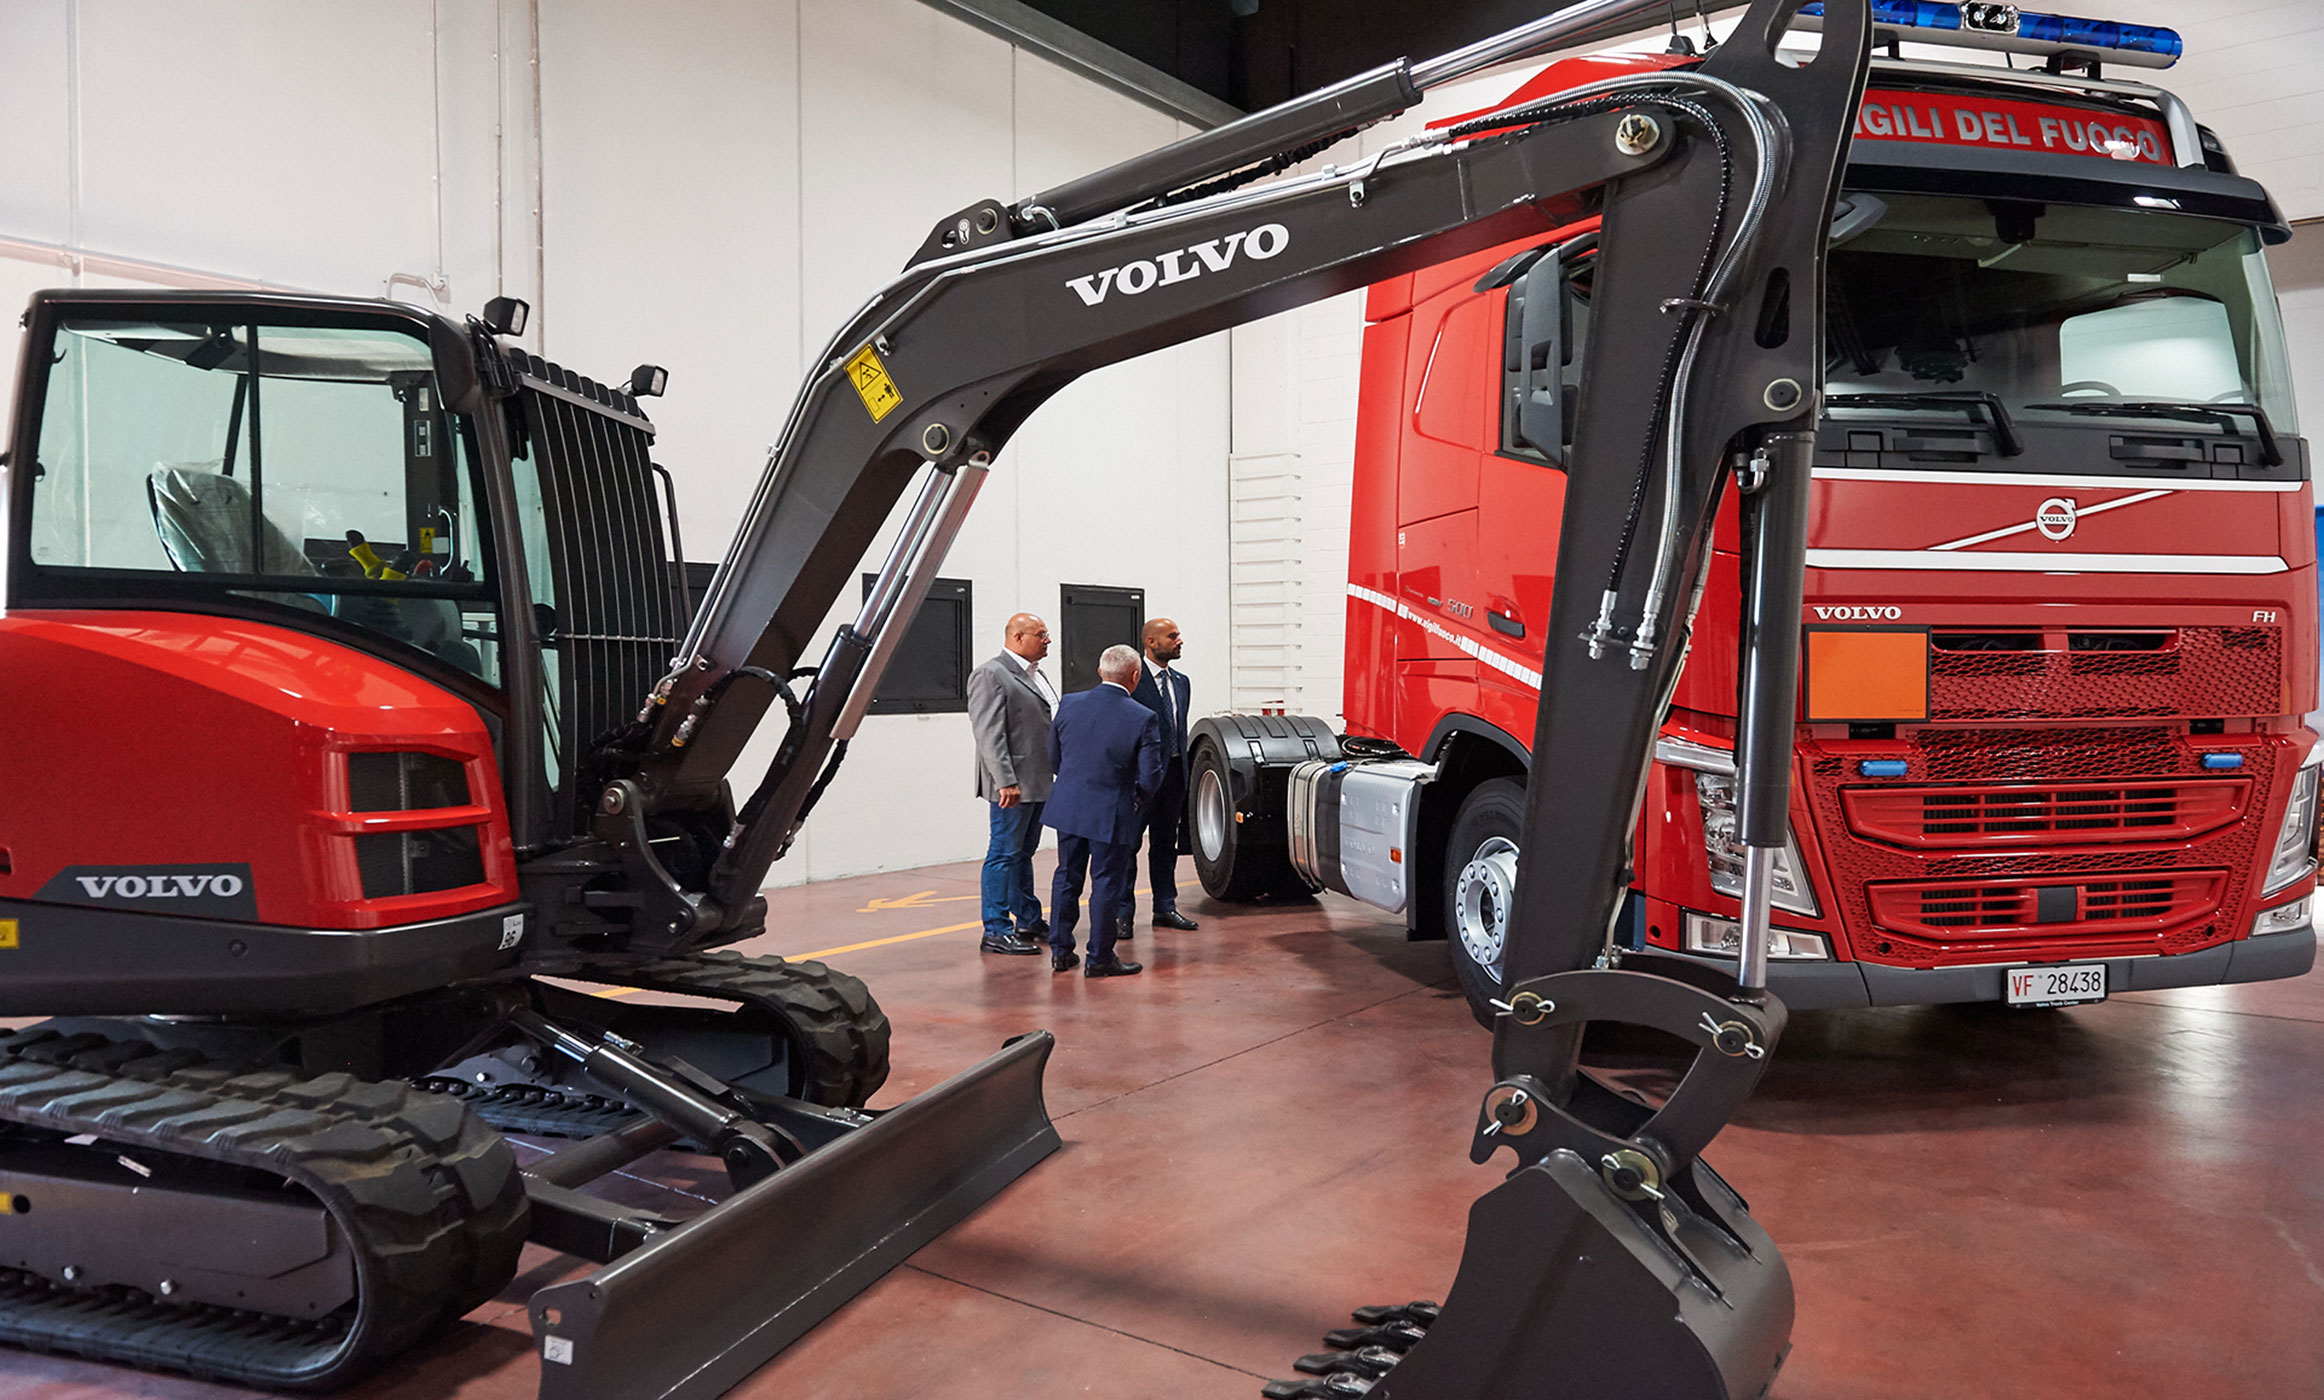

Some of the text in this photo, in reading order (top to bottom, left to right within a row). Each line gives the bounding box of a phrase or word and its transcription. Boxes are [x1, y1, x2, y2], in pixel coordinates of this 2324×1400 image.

[1954, 108, 2032, 146] DEL
[2038, 115, 2162, 162] FUOCO
[1065, 223, 1290, 307] VOLVO
[1447, 598, 1473, 620] 500
[1813, 606, 1902, 620] VOLVO
[2252, 610, 2276, 623] FH
[76, 874, 243, 898] VOLVO
[2012, 971, 2102, 997] VF 28438
